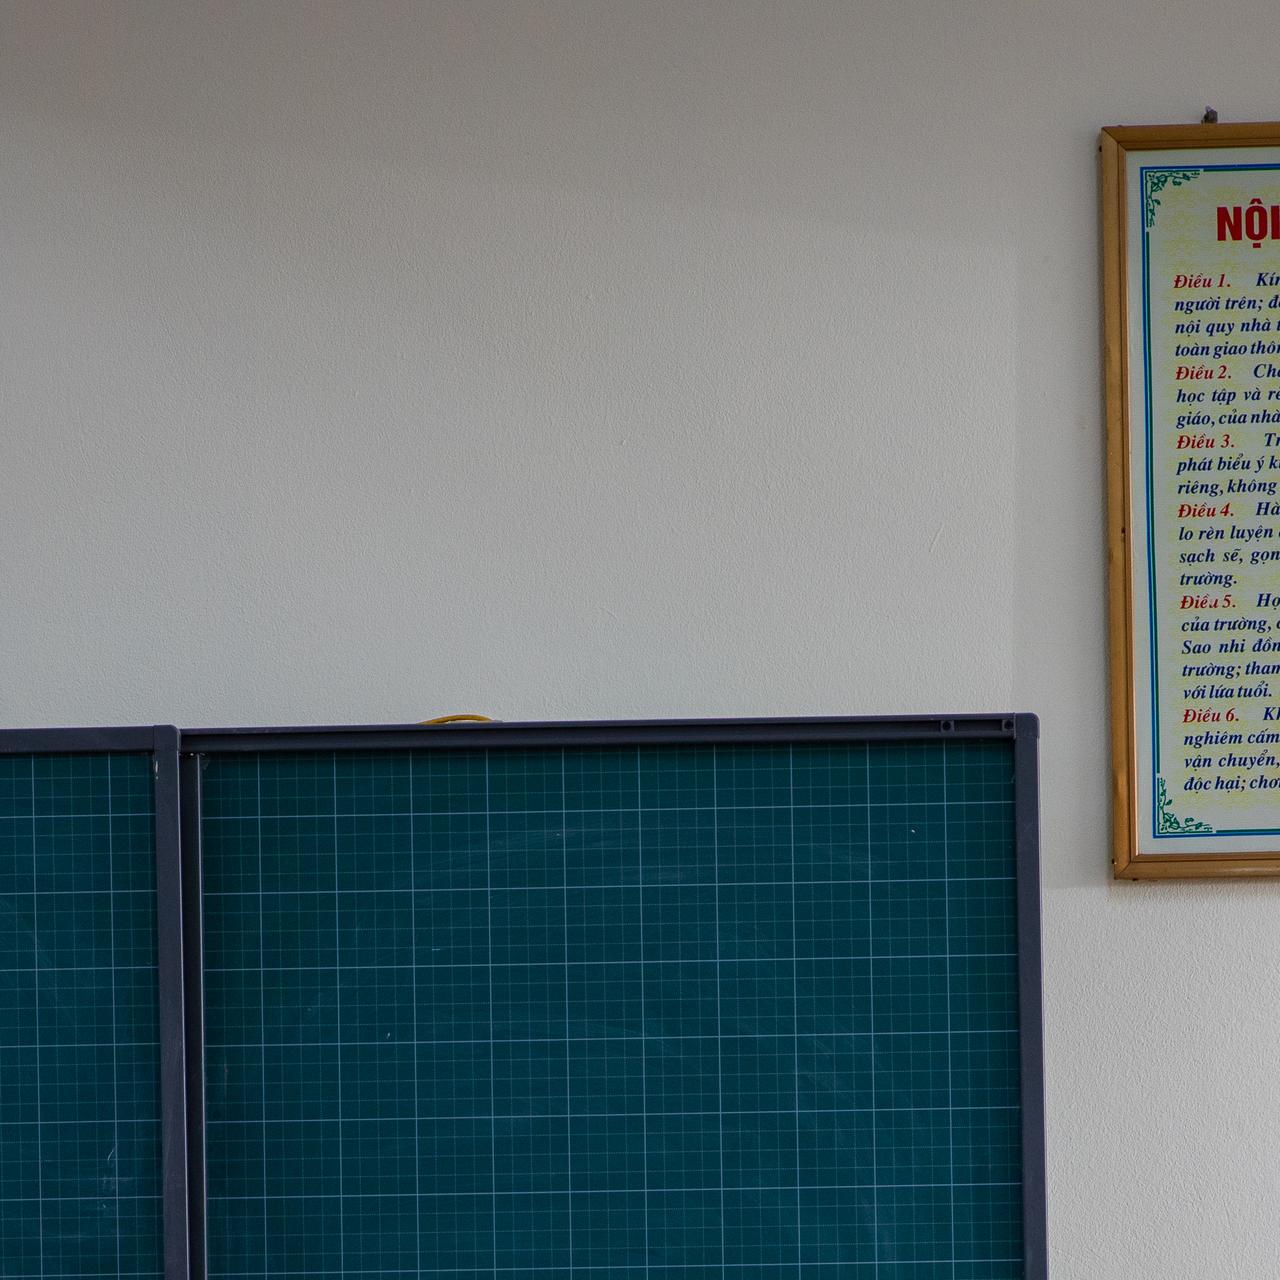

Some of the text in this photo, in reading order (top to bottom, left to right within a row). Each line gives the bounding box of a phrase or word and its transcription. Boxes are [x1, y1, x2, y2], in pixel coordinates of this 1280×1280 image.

[1218, 198, 1280, 248] NỘI
[1173, 272, 1212, 289] Điều
[1217, 273, 1231, 288] 1.
[1175, 364, 1214, 381] Điều
[1217, 364, 1232, 380] 2.
[1175, 388, 1206, 407] học
[1211, 387, 1237, 406] tập
[1243, 386, 1262, 401] và
[1176, 433, 1215, 450] Điều
[1220, 433, 1235, 449] 3.
[1178, 526, 1194, 541] lo
[1198, 525, 1225, 541] rèn
[1229, 524, 1274, 543] luyện
[1178, 548, 1216, 567] sạch
[1249, 550, 1280, 565] gọn
[1181, 639, 1212, 655] Sao
[1218, 638, 1246, 654] nhi
[1182, 706, 1221, 724] Điều
[1225, 707, 1240, 722] 6.
[1184, 754, 1212, 772] vận
[1217, 749, 1280, 771] chuyển,
